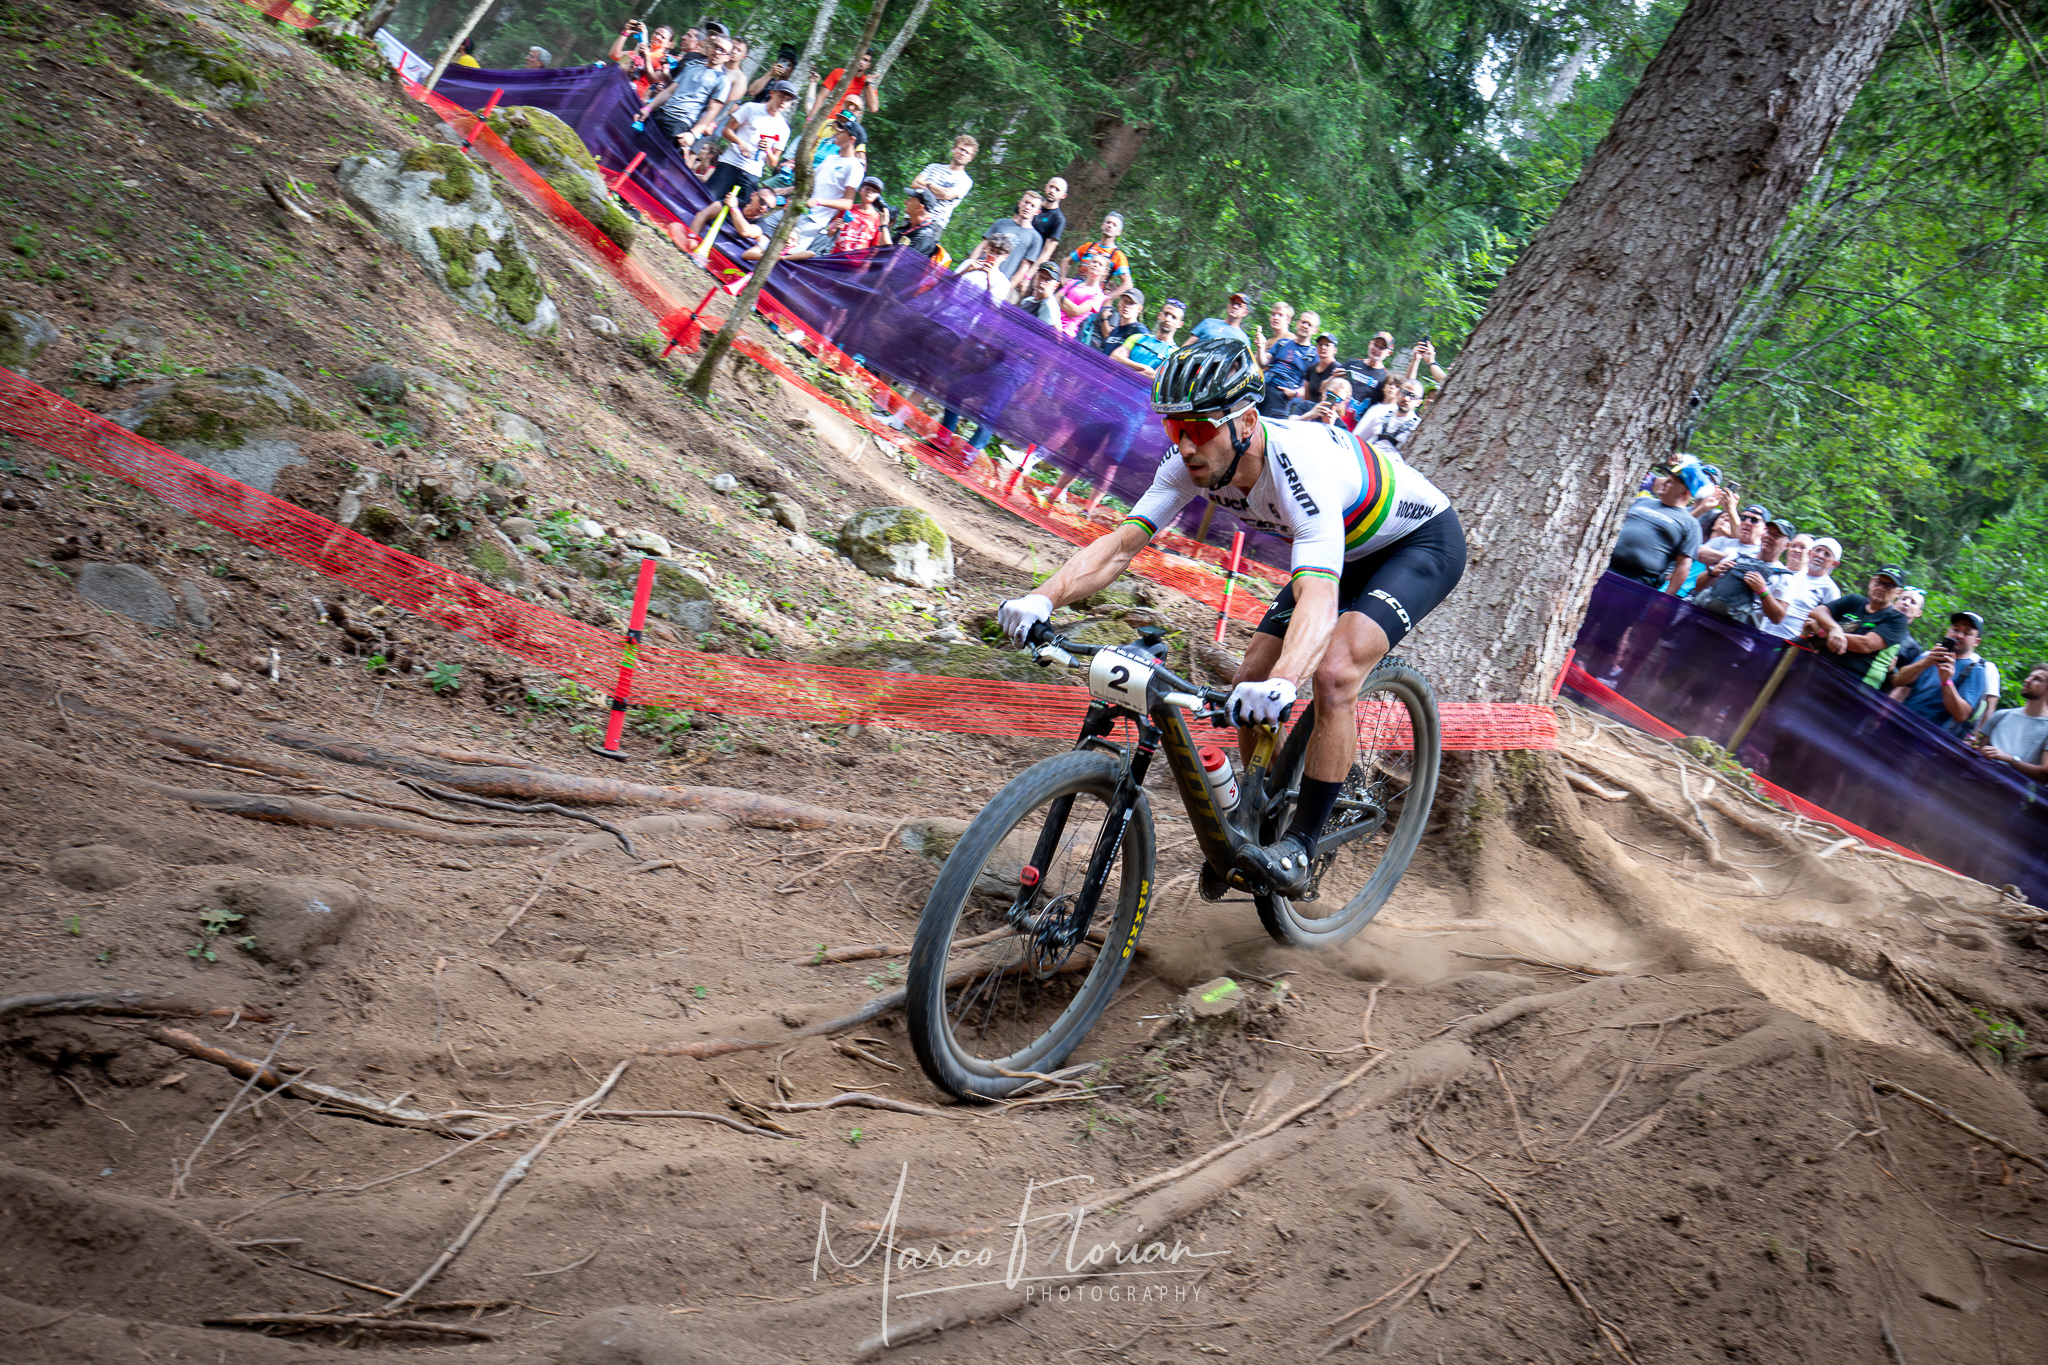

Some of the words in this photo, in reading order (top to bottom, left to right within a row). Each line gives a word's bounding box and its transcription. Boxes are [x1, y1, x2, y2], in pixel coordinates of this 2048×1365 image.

[1276, 452, 1320, 517] SRAM
[1368, 588, 1412, 632] SCOT
[1107, 665, 1130, 694] 2
[1157, 714, 1231, 848] SCOTT
[1122, 879, 1149, 959] MAXXIS
